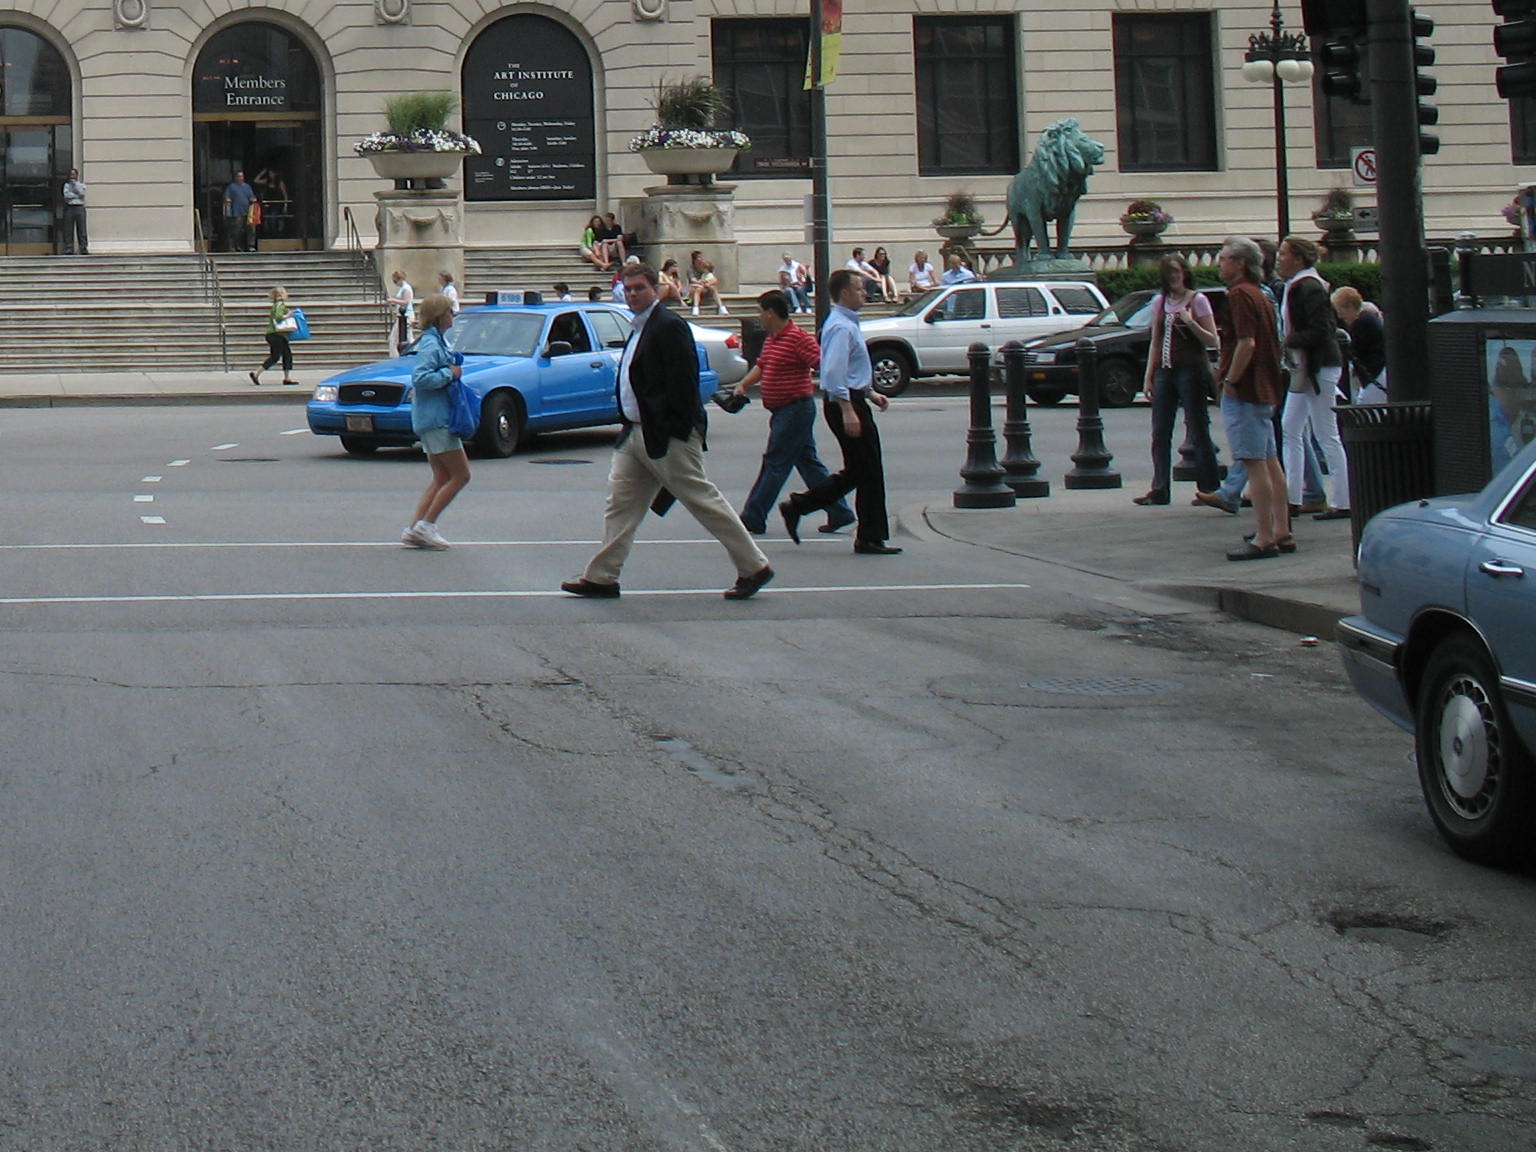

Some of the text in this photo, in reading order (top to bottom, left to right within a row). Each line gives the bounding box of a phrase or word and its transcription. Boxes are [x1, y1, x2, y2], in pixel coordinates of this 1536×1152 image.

[493, 70, 574, 80] ART INSTITUTE
[224, 75, 286, 89] Members
[226, 92, 285, 106] Entrance
[493, 91, 544, 100] CHICAGO
